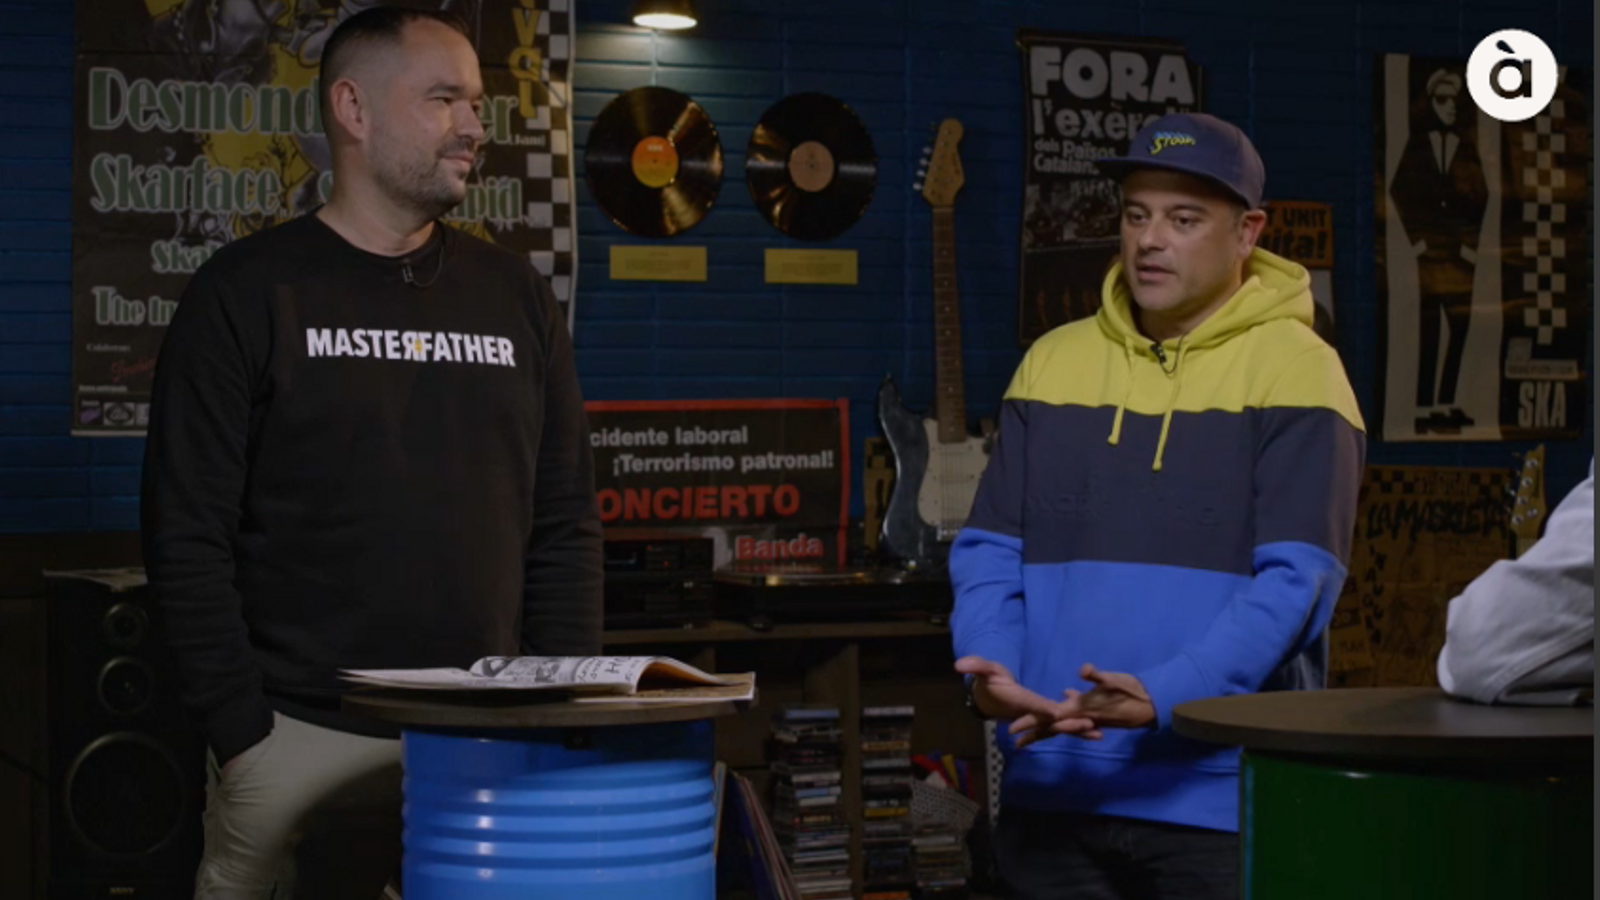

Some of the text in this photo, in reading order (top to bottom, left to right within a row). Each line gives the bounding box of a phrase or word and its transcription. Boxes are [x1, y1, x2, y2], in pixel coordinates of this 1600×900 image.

[1030, 45, 1195, 104] FORA
[88, 67, 325, 137] Desmond
[90, 153, 281, 213] Skarface
[1282, 208, 1327, 228] UNIT
[91, 285, 146, 326] The
[1517, 380, 1567, 428] SKA
[589, 425, 749, 447] cidente laboral
[612, 449, 834, 477] ¡Terrorismo patronal!
[596, 483, 801, 521] ONCIERTO
[734, 532, 824, 560] Banda
